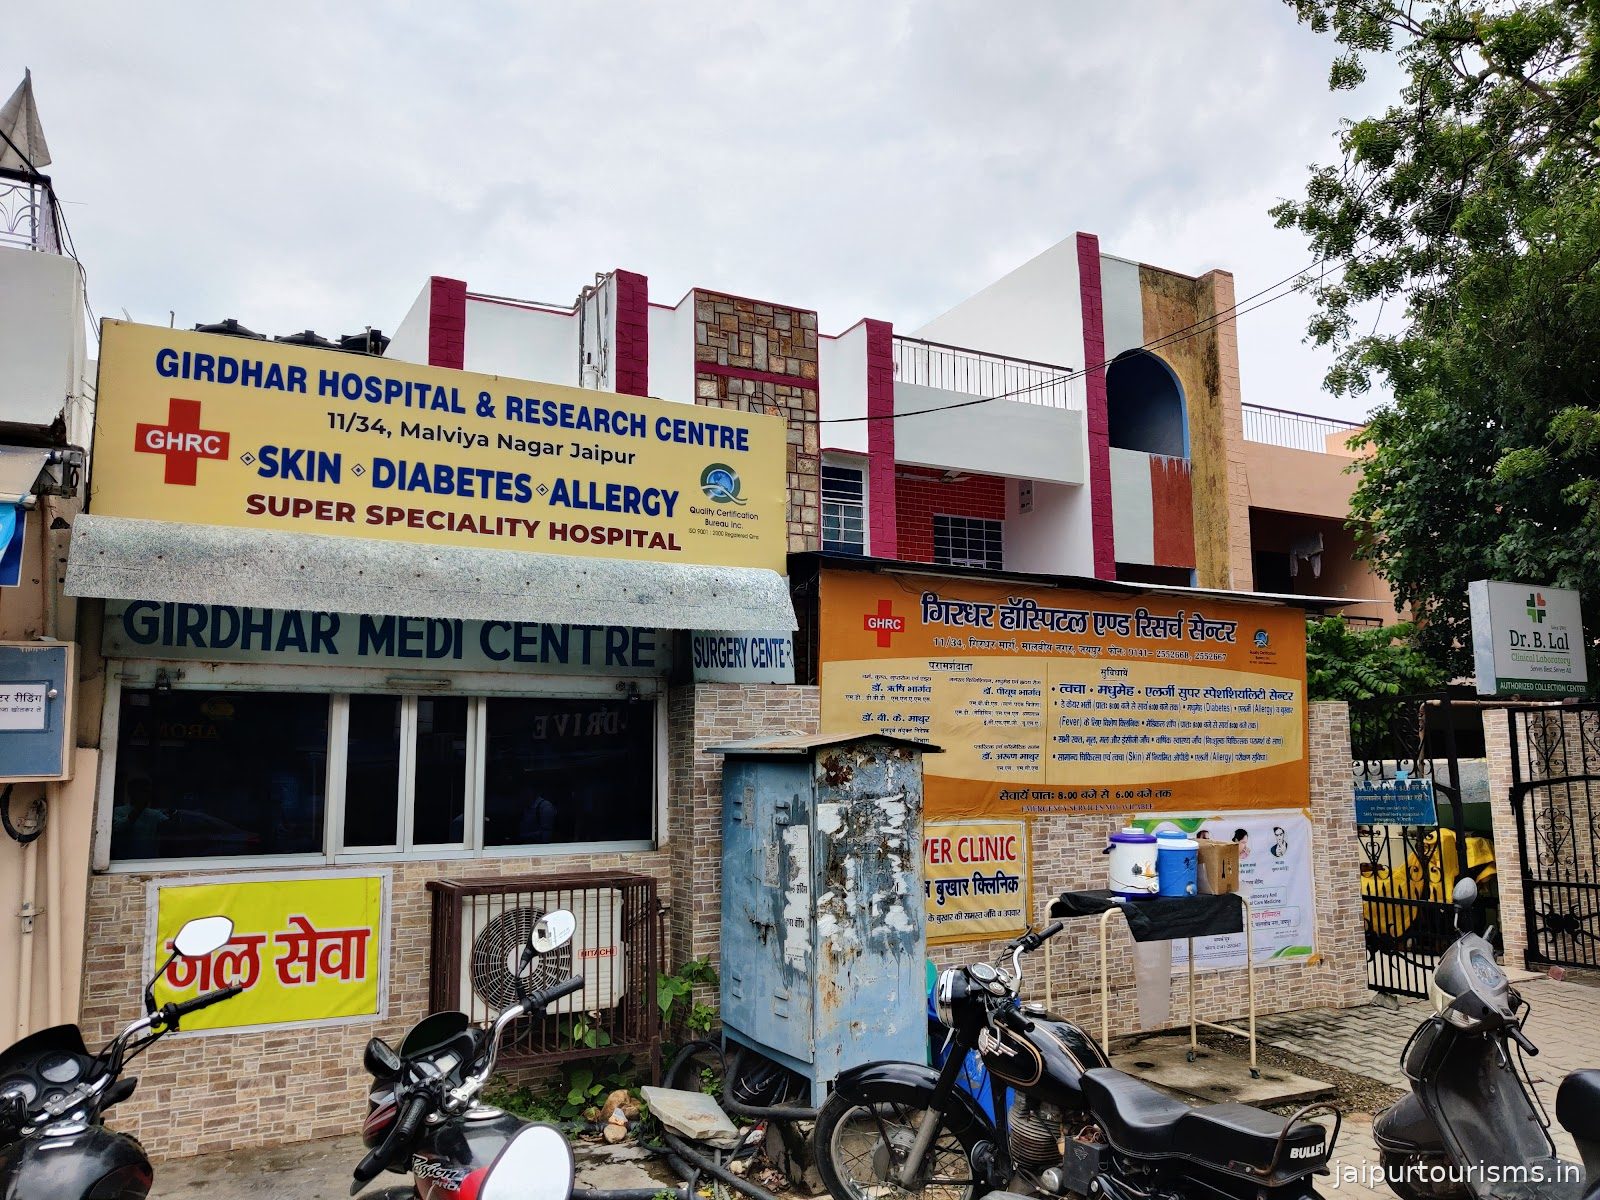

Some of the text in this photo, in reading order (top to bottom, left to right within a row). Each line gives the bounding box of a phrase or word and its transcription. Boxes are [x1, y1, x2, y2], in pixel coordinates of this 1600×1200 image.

[156, 348, 749, 451] GIRDHAR HOSPITAL & RESEARCH CENTRE
[145, 429, 221, 455] GHRC
[327, 412, 635, 465] 11/34, Malviya Nagar Jaipur
[257, 445, 680, 518] SKIN DIABETES ALLERGY
[689, 506, 759, 520] Quality Certification
[246, 494, 682, 551] SUPER SPECIALITY HOSPITAL
[704, 519, 729, 528] Bureau
[867, 617, 901, 630] GHRC
[921, 592, 1237, 643] गिरधर हॉस्पिटल एण्ड रिसर्च सेन्टर
[123, 600, 656, 667] GIRDHAR MEDI CENTRE
[1509, 629, 1570, 650] Dr. B. Lal
[694, 637, 748, 669] SURGERY
[1511, 652, 1571, 667] Clinical Laboratory
[907, 684, 932, 693] भार्गव
[1018, 688, 1041, 696] भार्गव
[1059, 683, 1086, 695] त्वचा
[1097, 683, 1135, 699] मधुमेह
[1178, 688, 1200, 702] सुपर
[1269, 689, 1294, 702] सेन्टर
[1500, 681, 1535, 691] AUTHORIZED
[1535, 683, 1566, 692] COLLECTION
[14, 691, 42, 703] रीडिंग
[908, 714, 931, 724] माथुर
[1019, 753, 1040, 762] माथुर
[1057, 791, 1077, 800] 8.00
[1115, 790, 1133, 799] 6.00
[923, 836, 1016, 864] VER CLINIC
[935, 879, 969, 905] बुखार
[972, 870, 1019, 896] क्लिनिक
[936, 913, 954, 924] बुखार
[274, 916, 371, 985] सेवा
[581, 949, 614, 957] HITACH
[1289, 1142, 1326, 1159] BULLET
